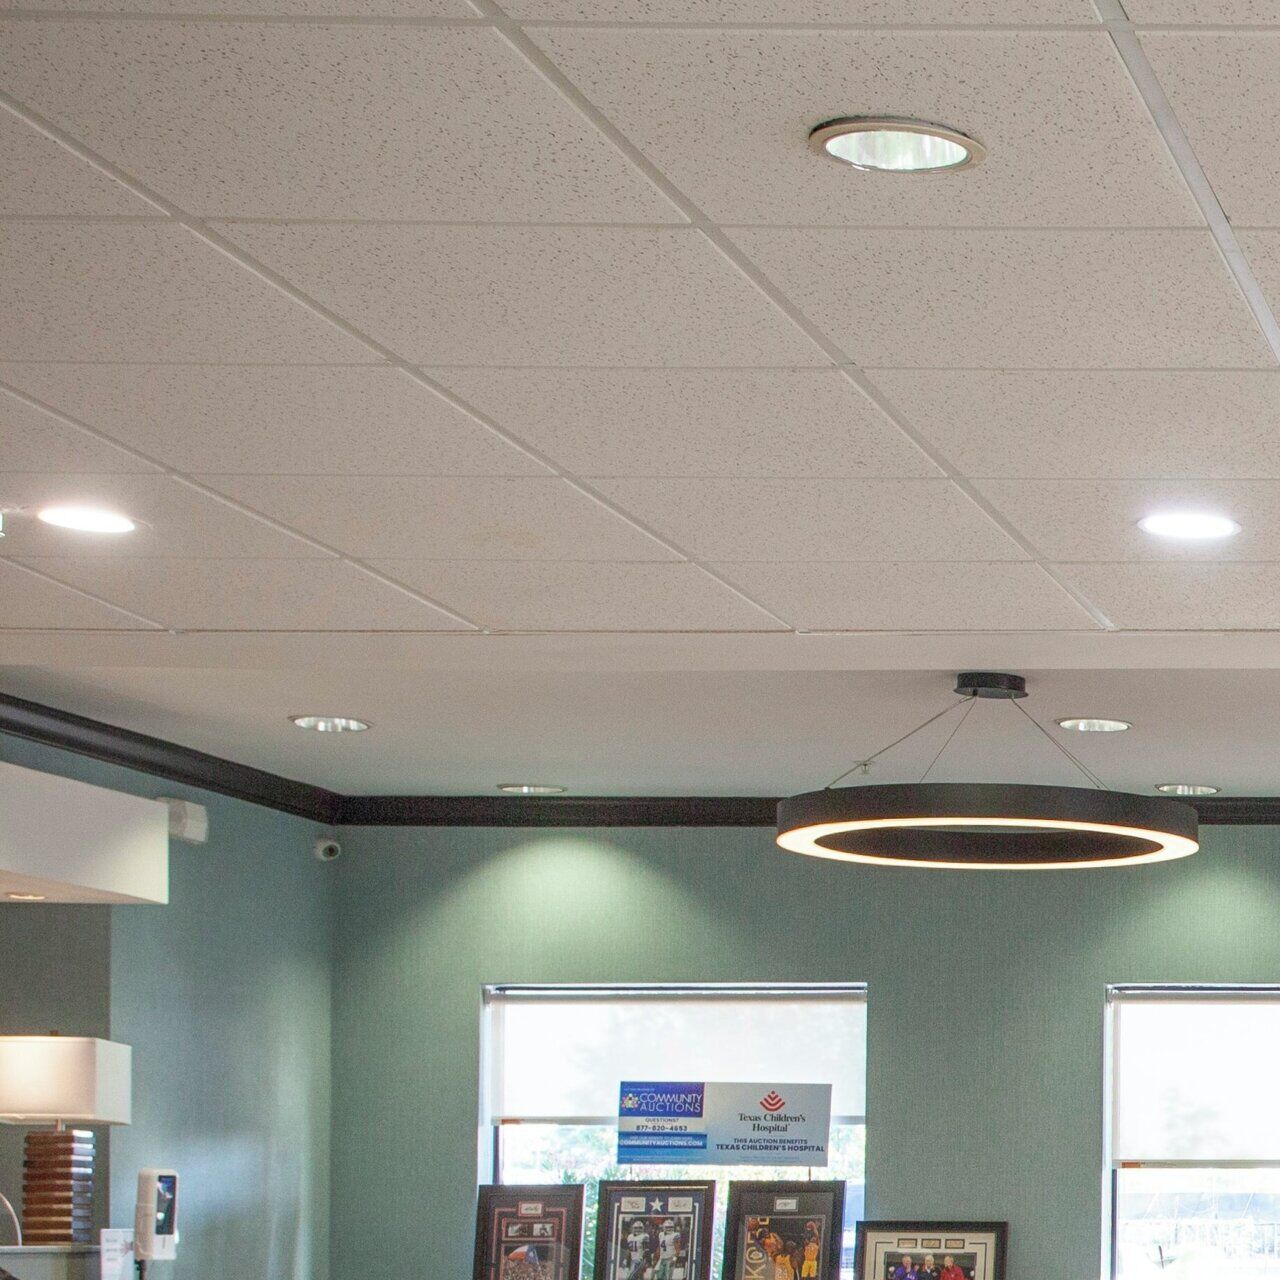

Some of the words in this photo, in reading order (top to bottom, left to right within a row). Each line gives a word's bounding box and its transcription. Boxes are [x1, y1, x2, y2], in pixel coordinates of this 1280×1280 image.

[639, 1093, 702, 1103] COMMUNITY
[640, 1102, 701, 1112] AUCTIONS
[738, 1113, 762, 1122] Texas
[763, 1113, 806, 1123] Children's
[752, 1123, 789, 1133] Hospital
